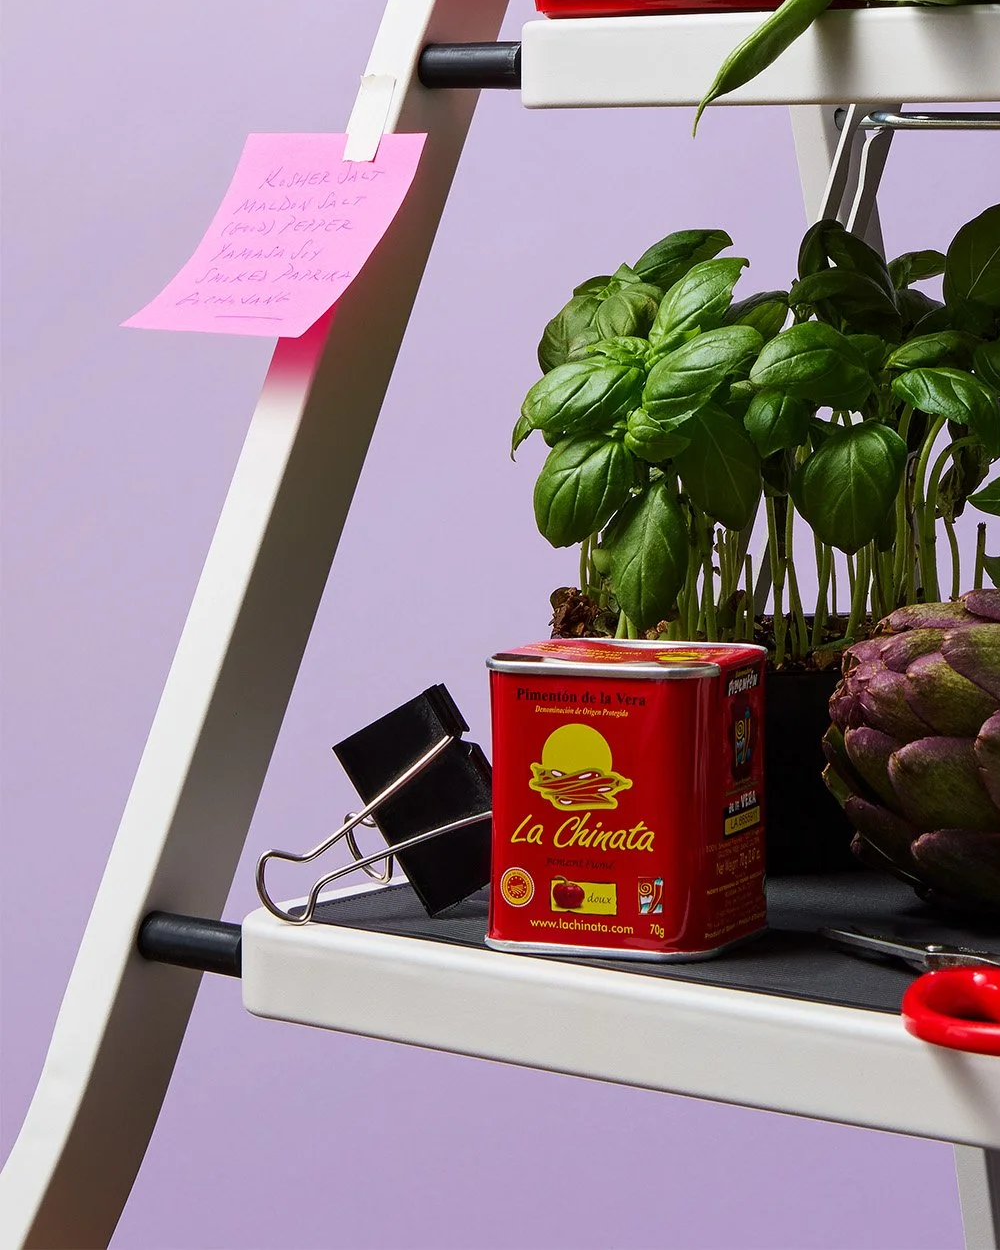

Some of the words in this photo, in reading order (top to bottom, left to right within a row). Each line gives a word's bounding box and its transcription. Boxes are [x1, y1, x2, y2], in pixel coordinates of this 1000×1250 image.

[337, 161, 386, 185] SALT
[317, 191, 368, 210] SALT
[278, 215, 354, 236] PEPPER
[271, 262, 352, 284] PAPRIKA
[516, 687, 578, 703] Pimentón
[581, 690, 597, 704] de
[599, 691, 612, 705] la
[615, 692, 647, 707] Vera
[574, 707, 582, 715] de
[582, 707, 602, 717] Origen
[510, 813, 545, 846] La
[553, 811, 656, 853] Chinata
[587, 892, 613, 904] doux
[529, 917, 634, 935] www.lachinata.com
[649, 923, 666, 939] 70g
